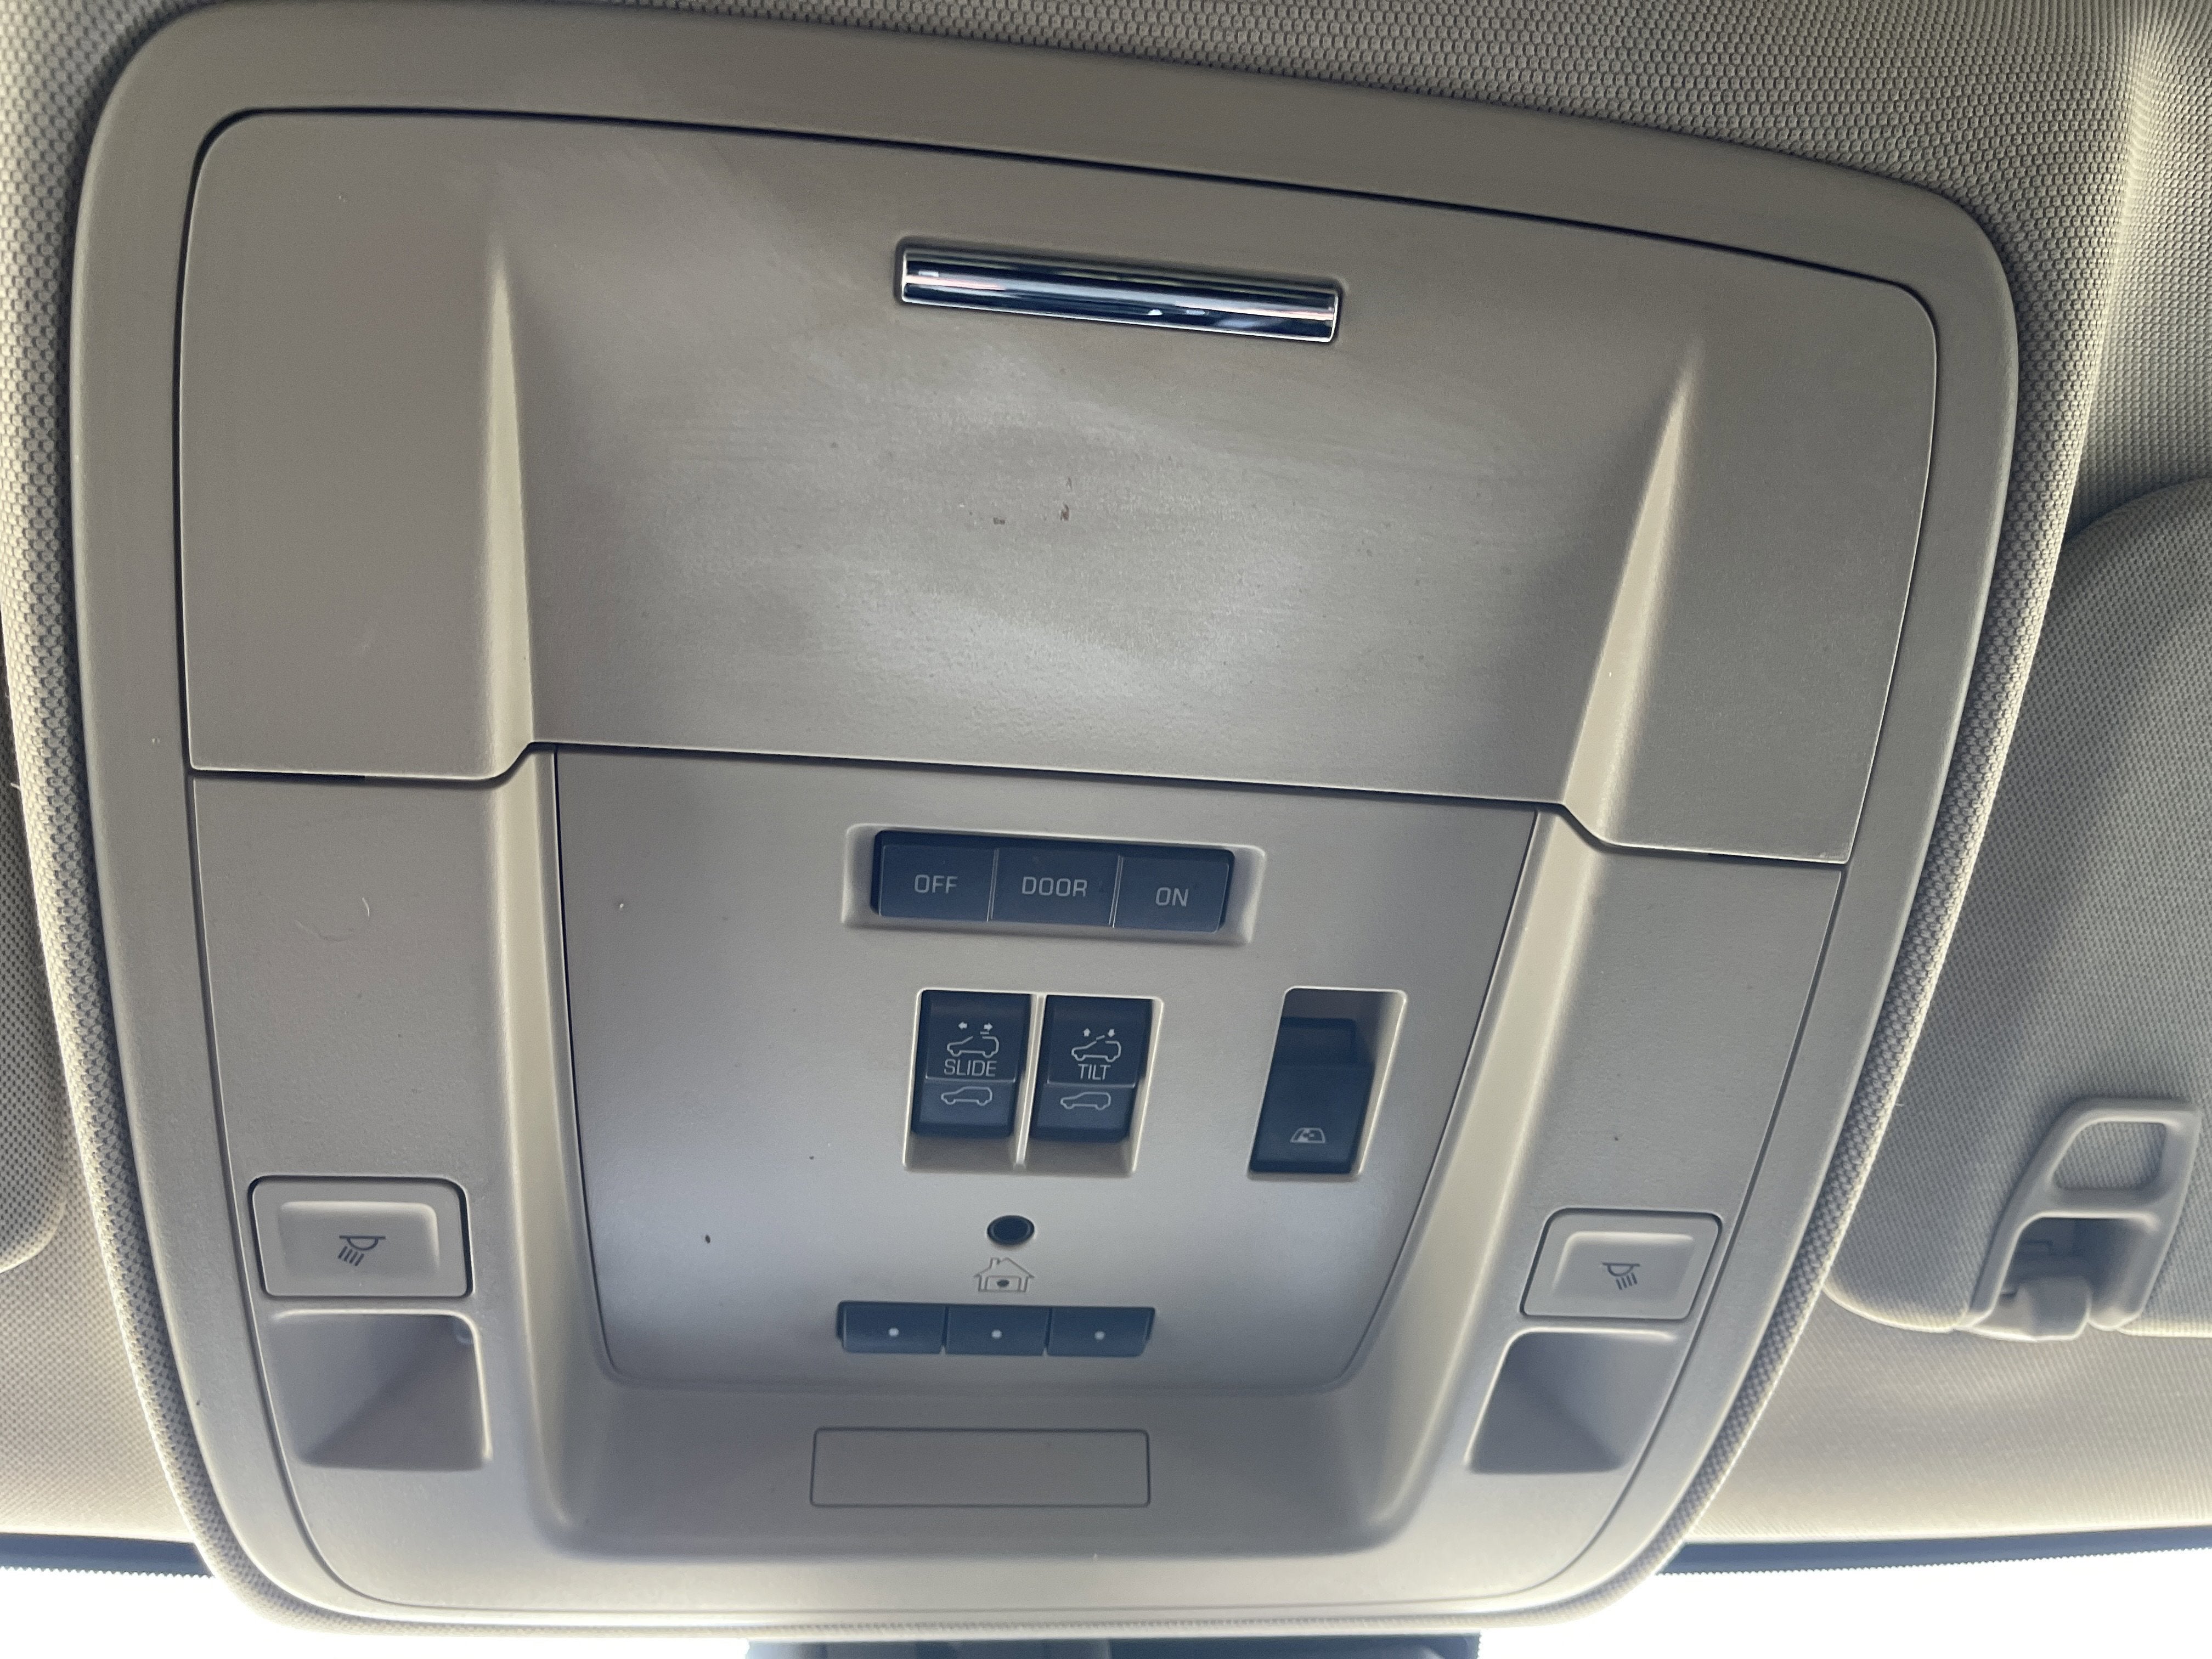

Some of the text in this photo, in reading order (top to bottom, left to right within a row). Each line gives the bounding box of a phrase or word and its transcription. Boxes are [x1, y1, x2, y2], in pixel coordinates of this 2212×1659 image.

[915, 874, 958, 893] OFF
[1022, 876, 1087, 898] DOOR
[1155, 887, 1189, 906] ON
[944, 1059, 997, 1077] SLIDE
[1078, 1063, 1111, 1080] TILT
